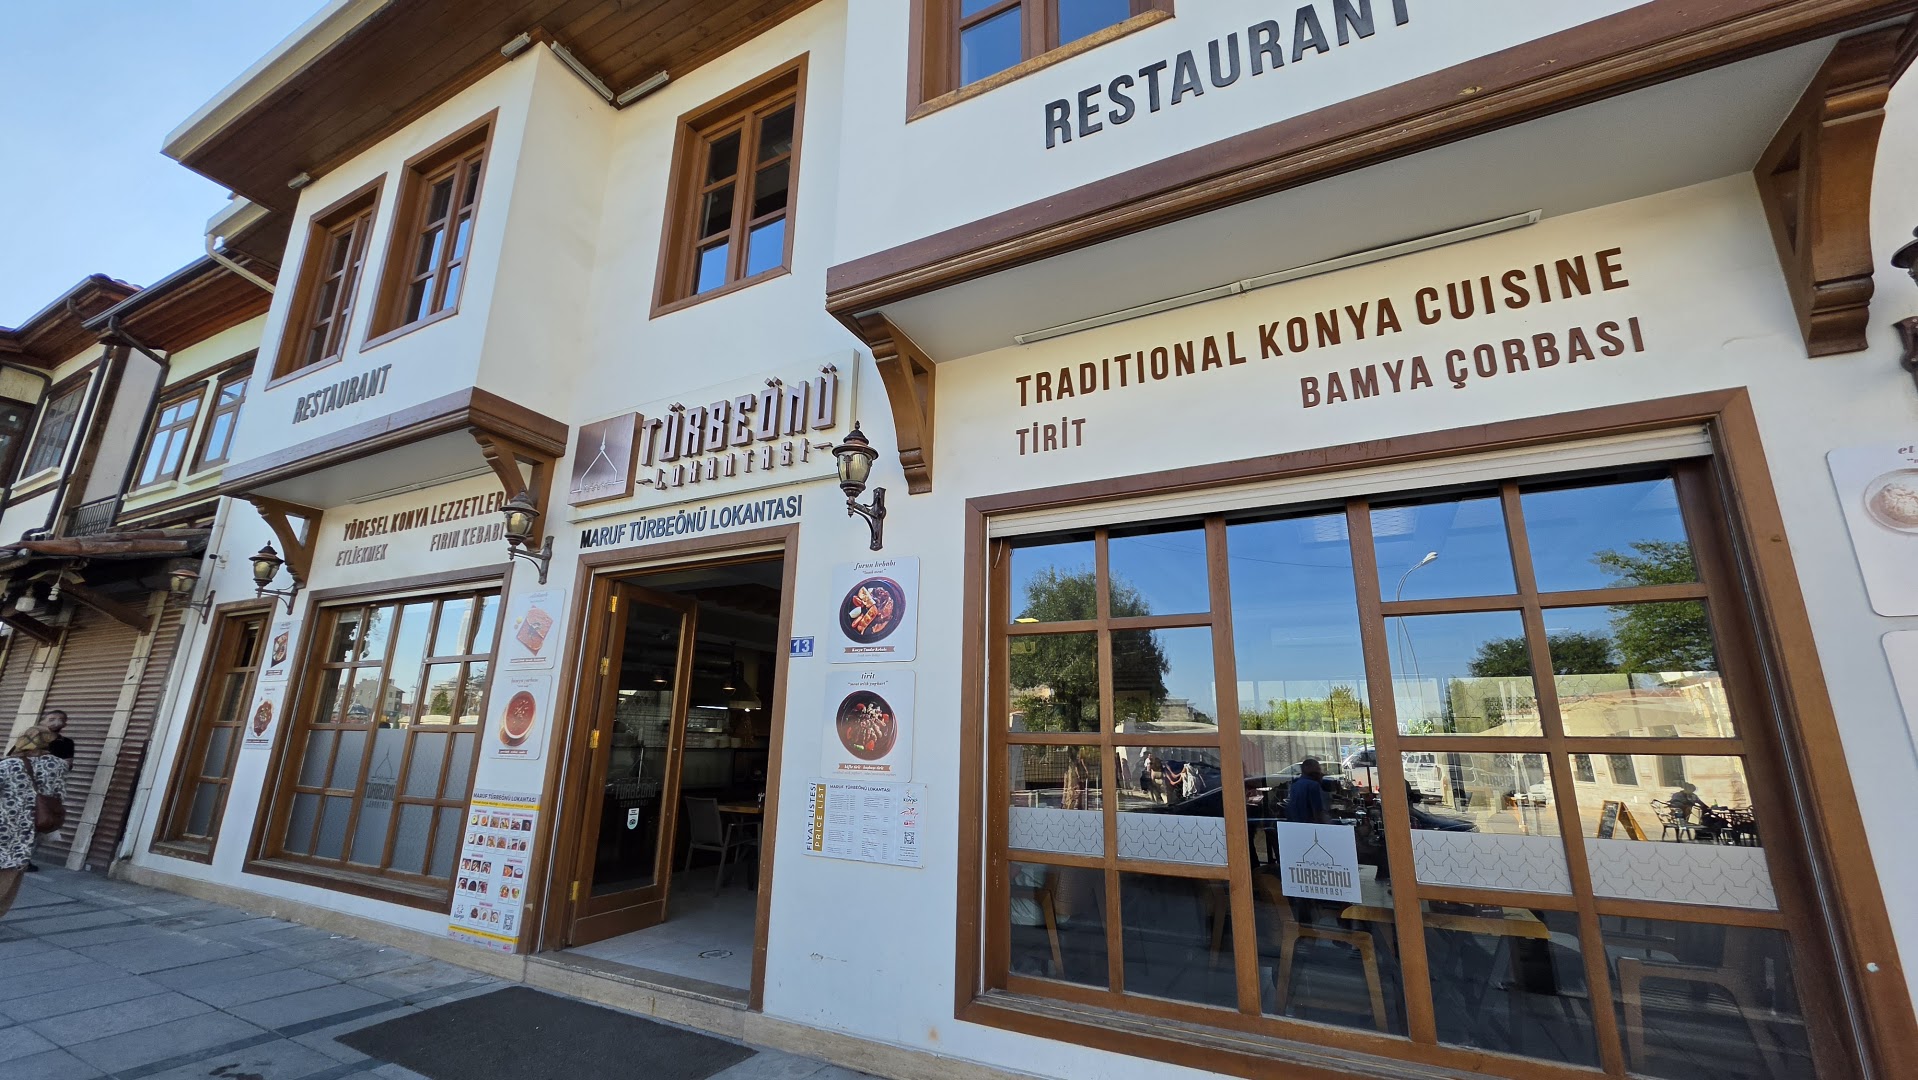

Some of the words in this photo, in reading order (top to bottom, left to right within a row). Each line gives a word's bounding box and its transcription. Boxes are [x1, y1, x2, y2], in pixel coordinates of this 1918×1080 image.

[1016, 331, 1247, 407] TRADITIONAL
[1258, 296, 1402, 360] KONYA
[1415, 246, 1629, 325] CUISINE
[1300, 355, 1433, 408] BAMYA
[1445, 316, 1645, 389] ÇORBASI
[291, 363, 392, 424] RESTAURANT
[641, 362, 838, 467] TÜRBEÖNÜ
[1016, 416, 1086, 455] TİRİT
[654, 437, 808, 490] LOKANTASI
[335, 543, 388, 567] ETLİEKMEK
[430, 529, 460, 551] FIRIN
[461, 521, 506, 546] KEBABI
[343, 515, 389, 541] YÖRESEL
[390, 506, 429, 533] KONYA
[580, 523, 627, 548] MARUF
[629, 505, 707, 541] TÜRBEÖNÜ
[710, 494, 802, 529] LOKANTASI
[793, 639, 810, 653] 13
[808, 782, 816, 818] LİSTESİ
[1289, 864, 1352, 888] TÜRBEÖNÜ
[1300, 885, 1343, 896] LOKANTASI
